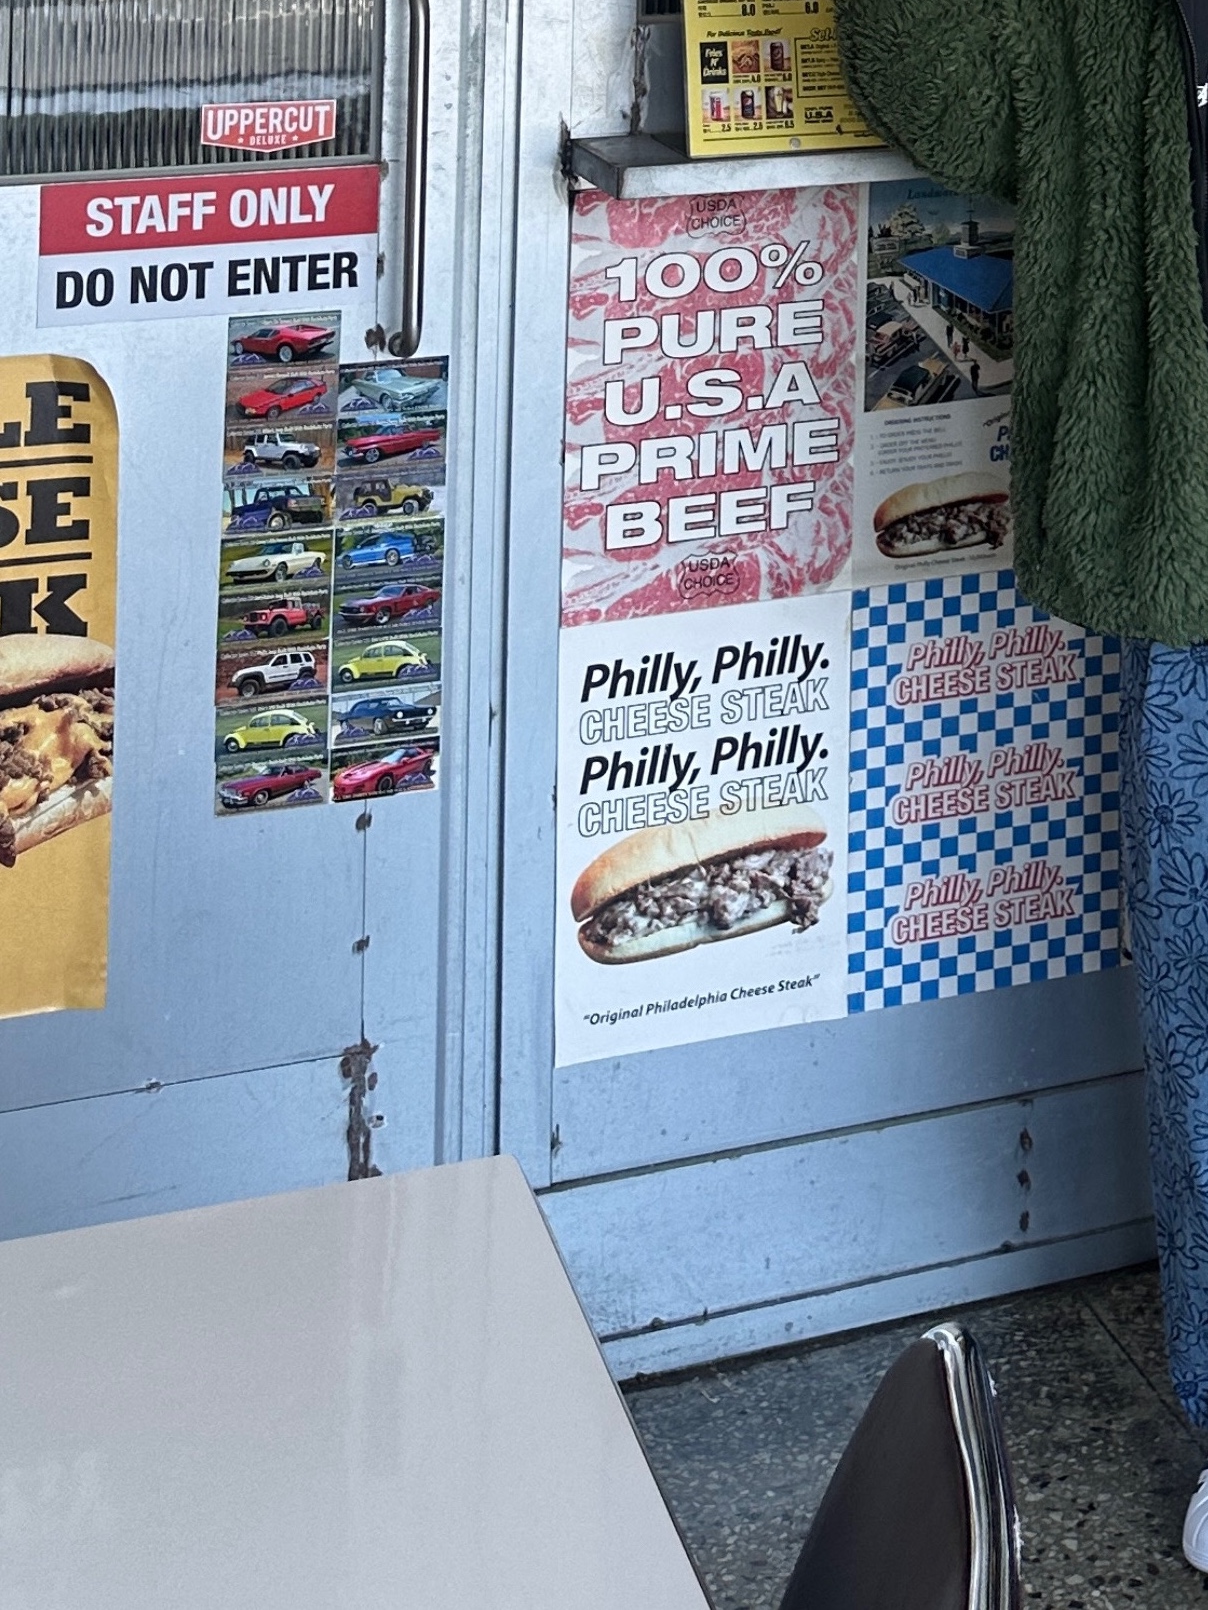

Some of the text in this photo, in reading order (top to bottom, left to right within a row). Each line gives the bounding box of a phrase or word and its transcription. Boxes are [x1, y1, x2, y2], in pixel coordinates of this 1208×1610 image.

[207, 105, 330, 140] UPPERCUT
[249, 135, 287, 146] DELUXE
[86, 184, 336, 239] STAFF ONLY
[690, 215, 741, 229] CHOICE
[696, 198, 737, 214] USDA
[55, 251, 359, 311] DO NOT ENTER
[604, 240, 824, 304] 100%
[602, 300, 825, 366] PURE
[604, 361, 822, 427] U.S.A
[580, 418, 840, 493] PRIME
[604, 481, 816, 551] BEEF
[580, 634, 830, 703] Philly, Philly.
[908, 624, 1065, 671] Philly, Philly.
[892, 653, 1076, 706] CHEESE STEAK
[579, 678, 829, 747] CHEESE STEAK
[646, 990, 727, 1015] Philadelphia
[730, 984, 775, 1000] Cheese
